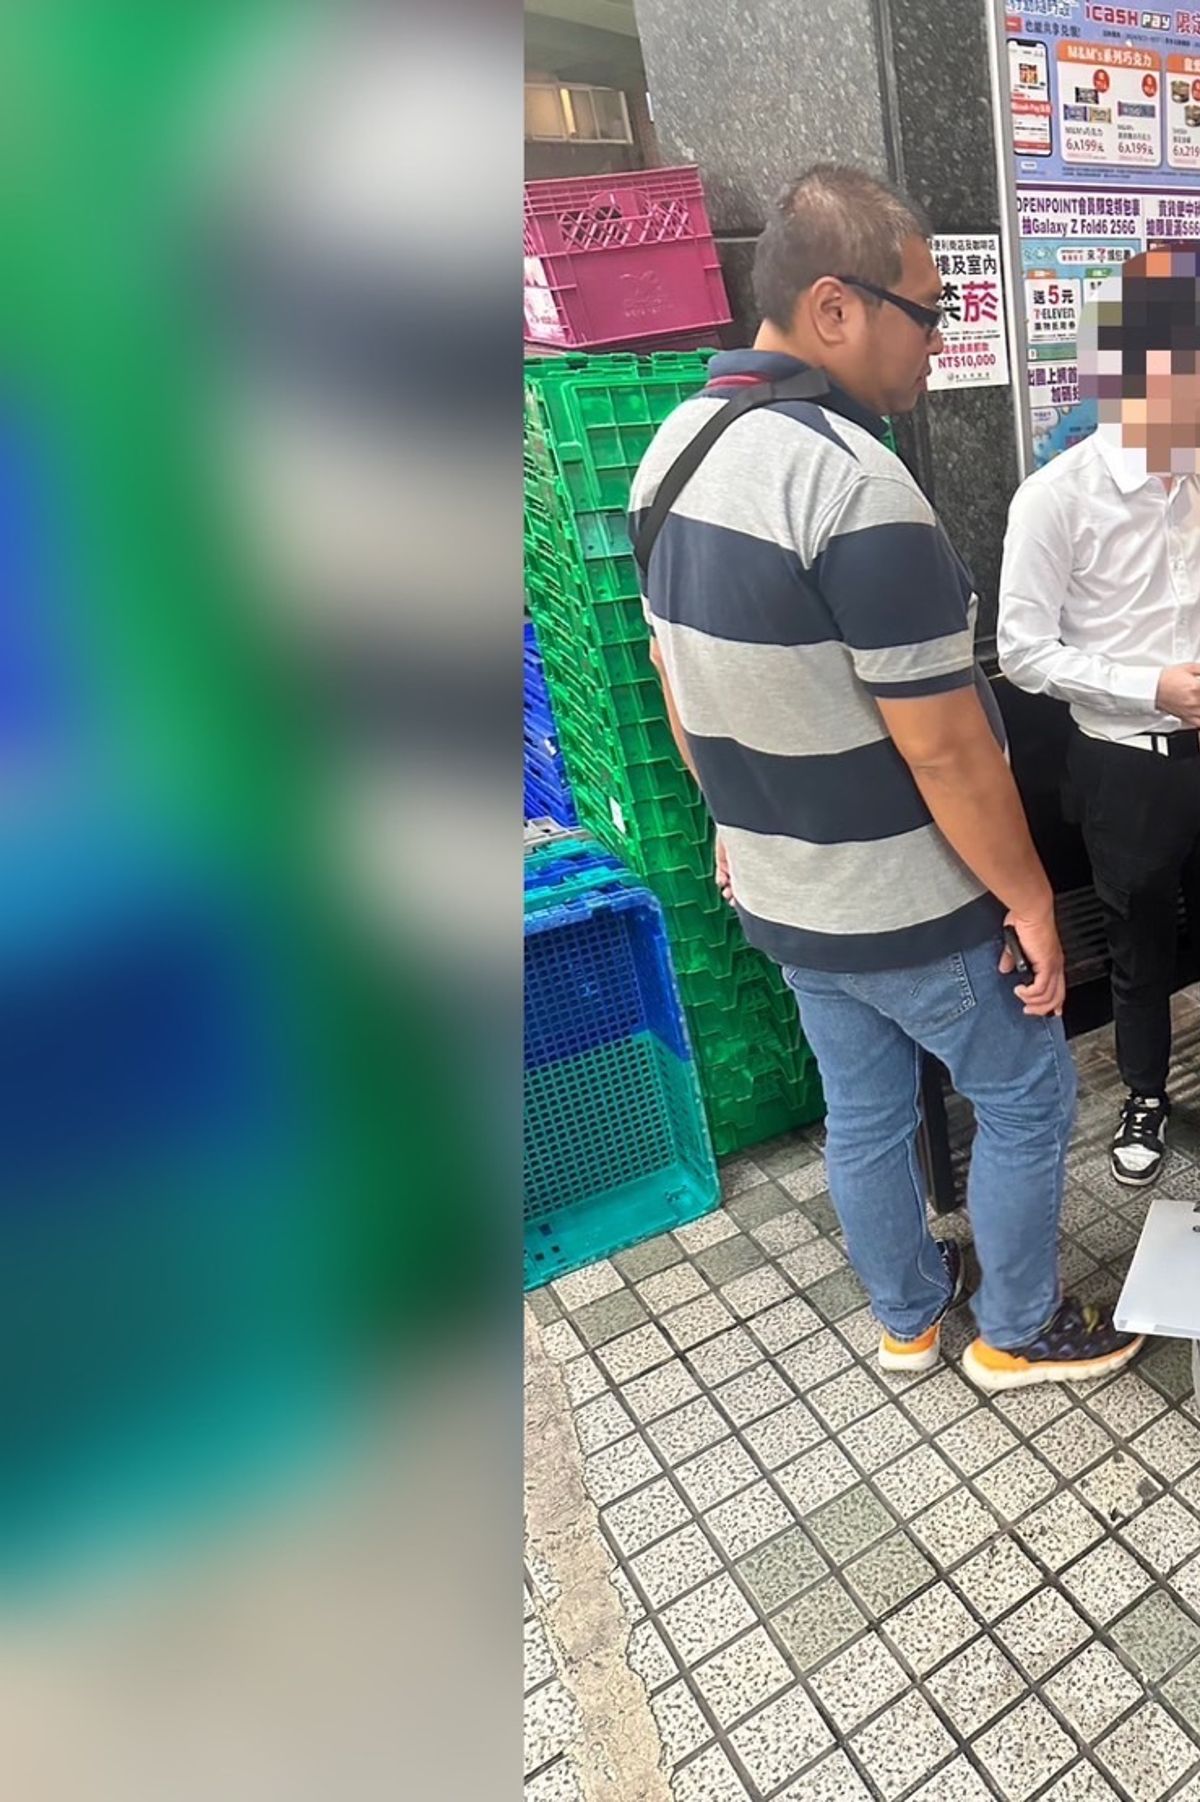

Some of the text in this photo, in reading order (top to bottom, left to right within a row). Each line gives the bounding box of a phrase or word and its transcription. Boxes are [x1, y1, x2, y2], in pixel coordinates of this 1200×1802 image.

[1071, 219, 1078, 234] Z
[1081, 219, 1108, 234] Fold6
[1110, 219, 1136, 234] 256G
[1033, 285, 1074, 304] 送5元
[938, 353, 996, 369] NT$10,000
